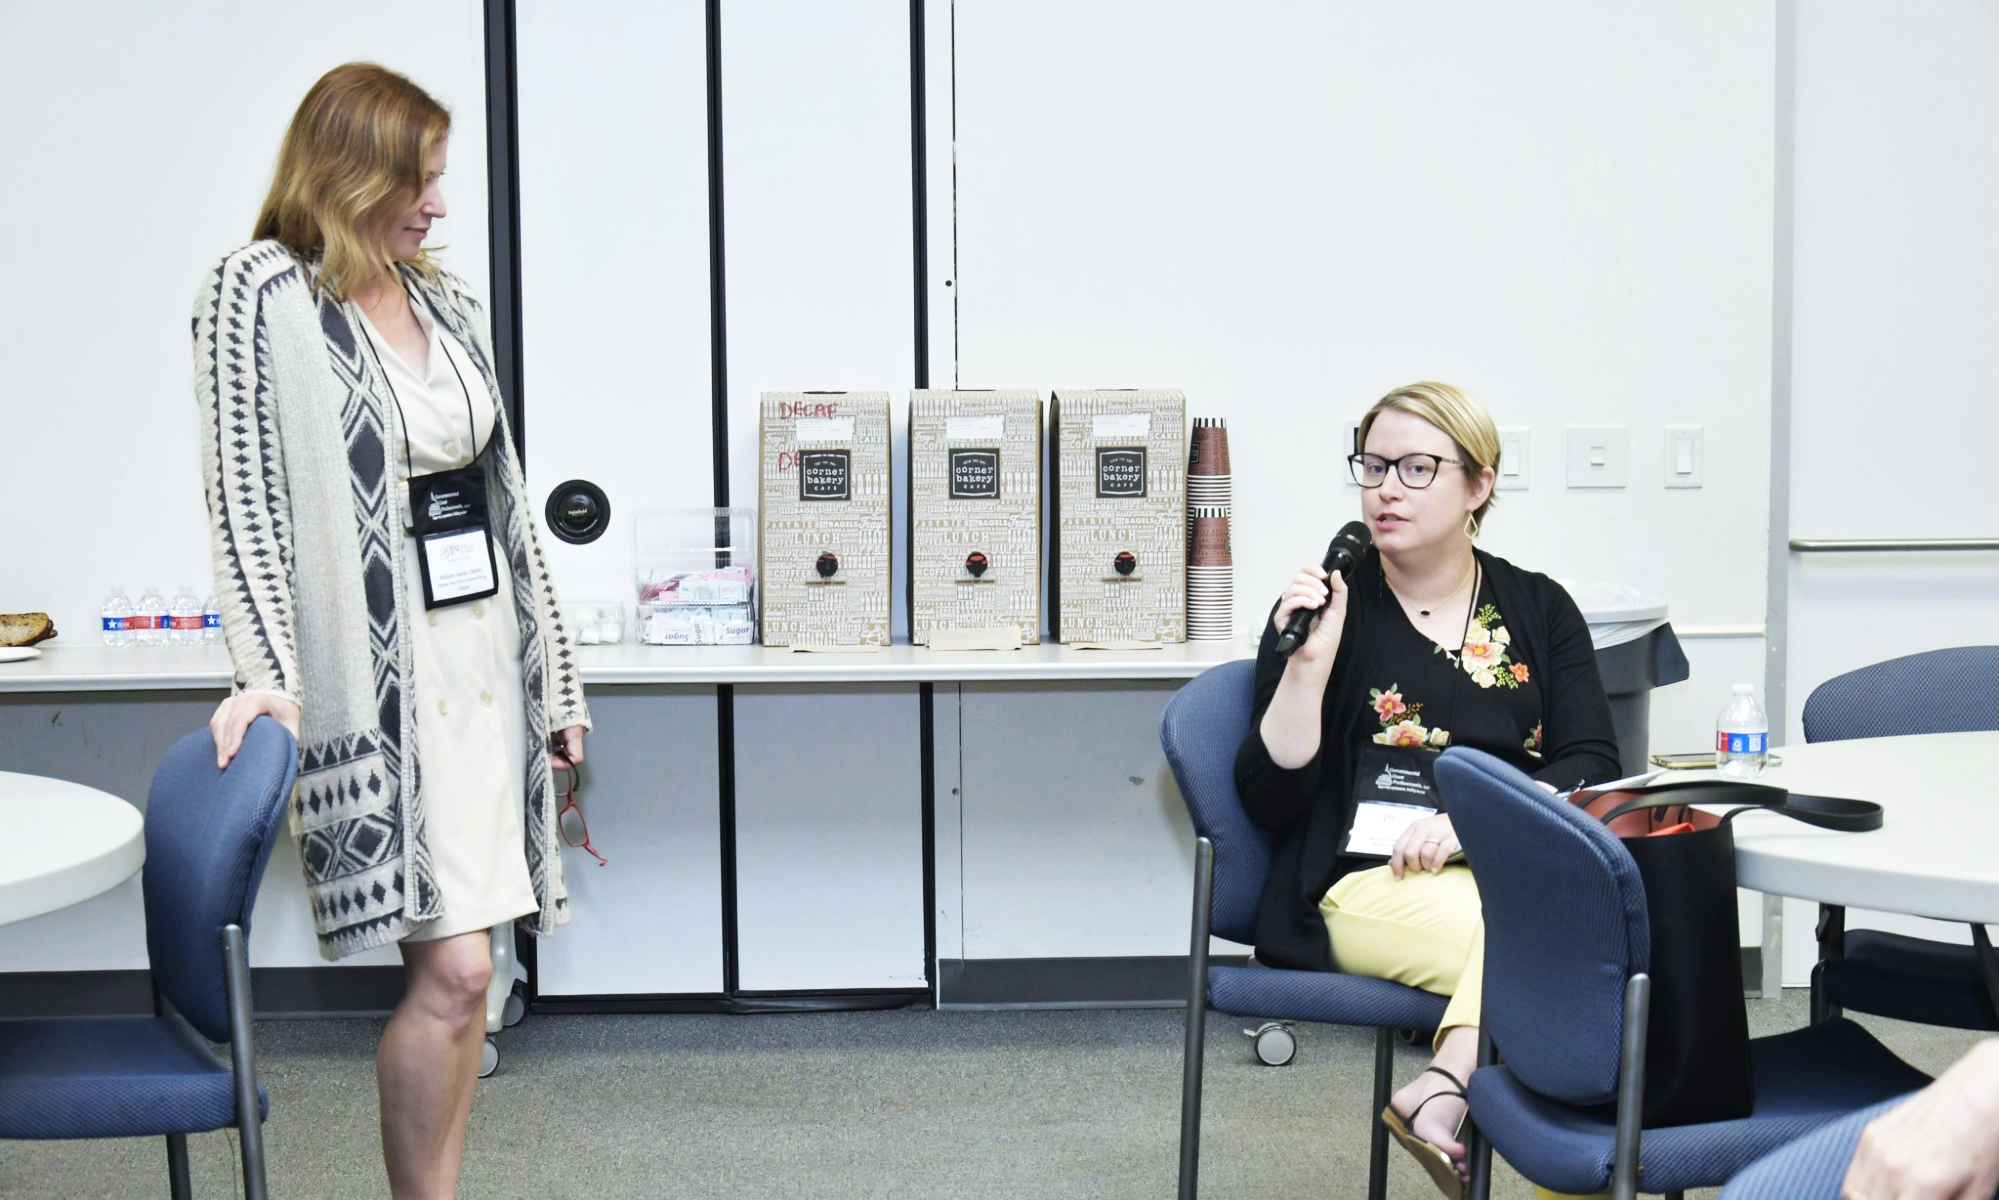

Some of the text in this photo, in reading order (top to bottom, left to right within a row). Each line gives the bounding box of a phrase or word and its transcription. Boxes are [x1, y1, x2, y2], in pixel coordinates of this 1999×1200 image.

[780, 401, 839, 420] DECAF
[779, 452, 800, 472] DE
[807, 476, 844, 484] bakery
[956, 474, 993, 483] bakery
[1103, 473, 1140, 481] bakery
[795, 533, 840, 544] LUNCH
[944, 531, 989, 542] LUNCH
[1091, 529, 1136, 540] LUNCH
[765, 622, 806, 632] LUNCH
[914, 620, 956, 630] LUNCH
[1061, 618, 1102, 628] LUNCH
[665, 632, 689, 641] Sugar
